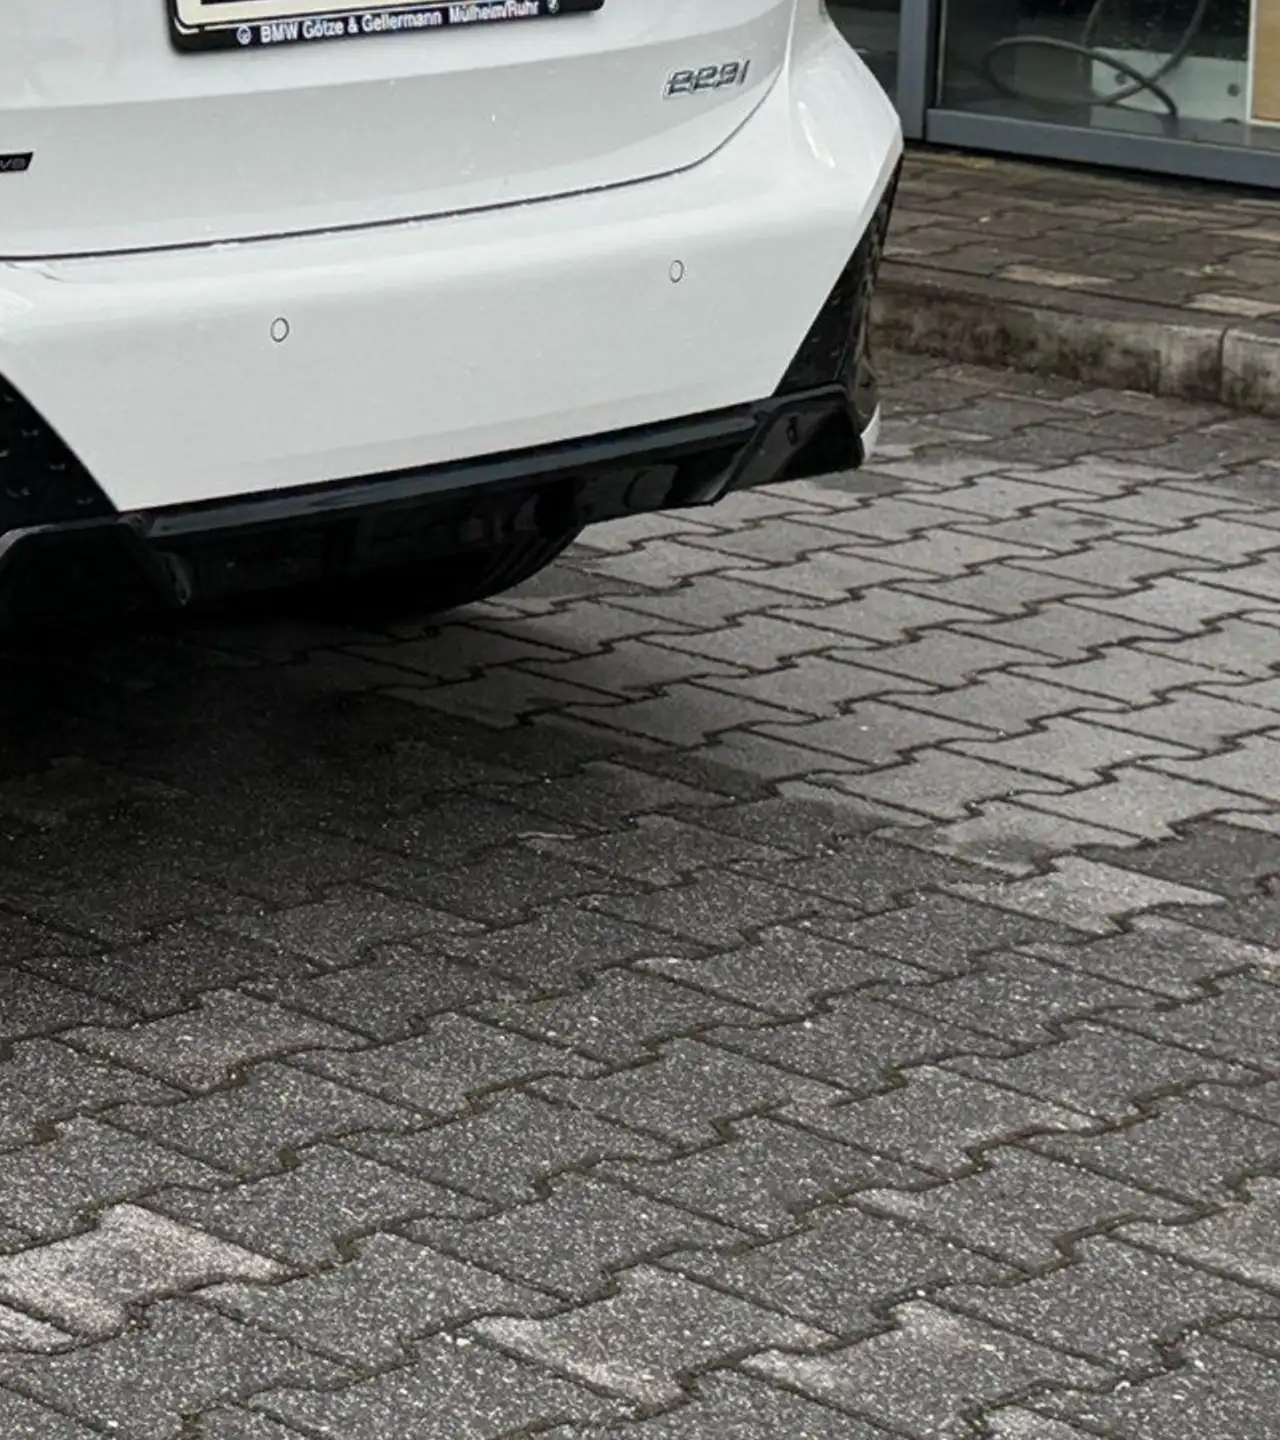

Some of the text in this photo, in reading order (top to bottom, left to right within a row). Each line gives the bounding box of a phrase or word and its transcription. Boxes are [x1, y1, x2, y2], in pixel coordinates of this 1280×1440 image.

[260, 22, 298, 44] BMW
[347, 15, 359, 34] &
[362, 11, 443, 33] Gellermann
